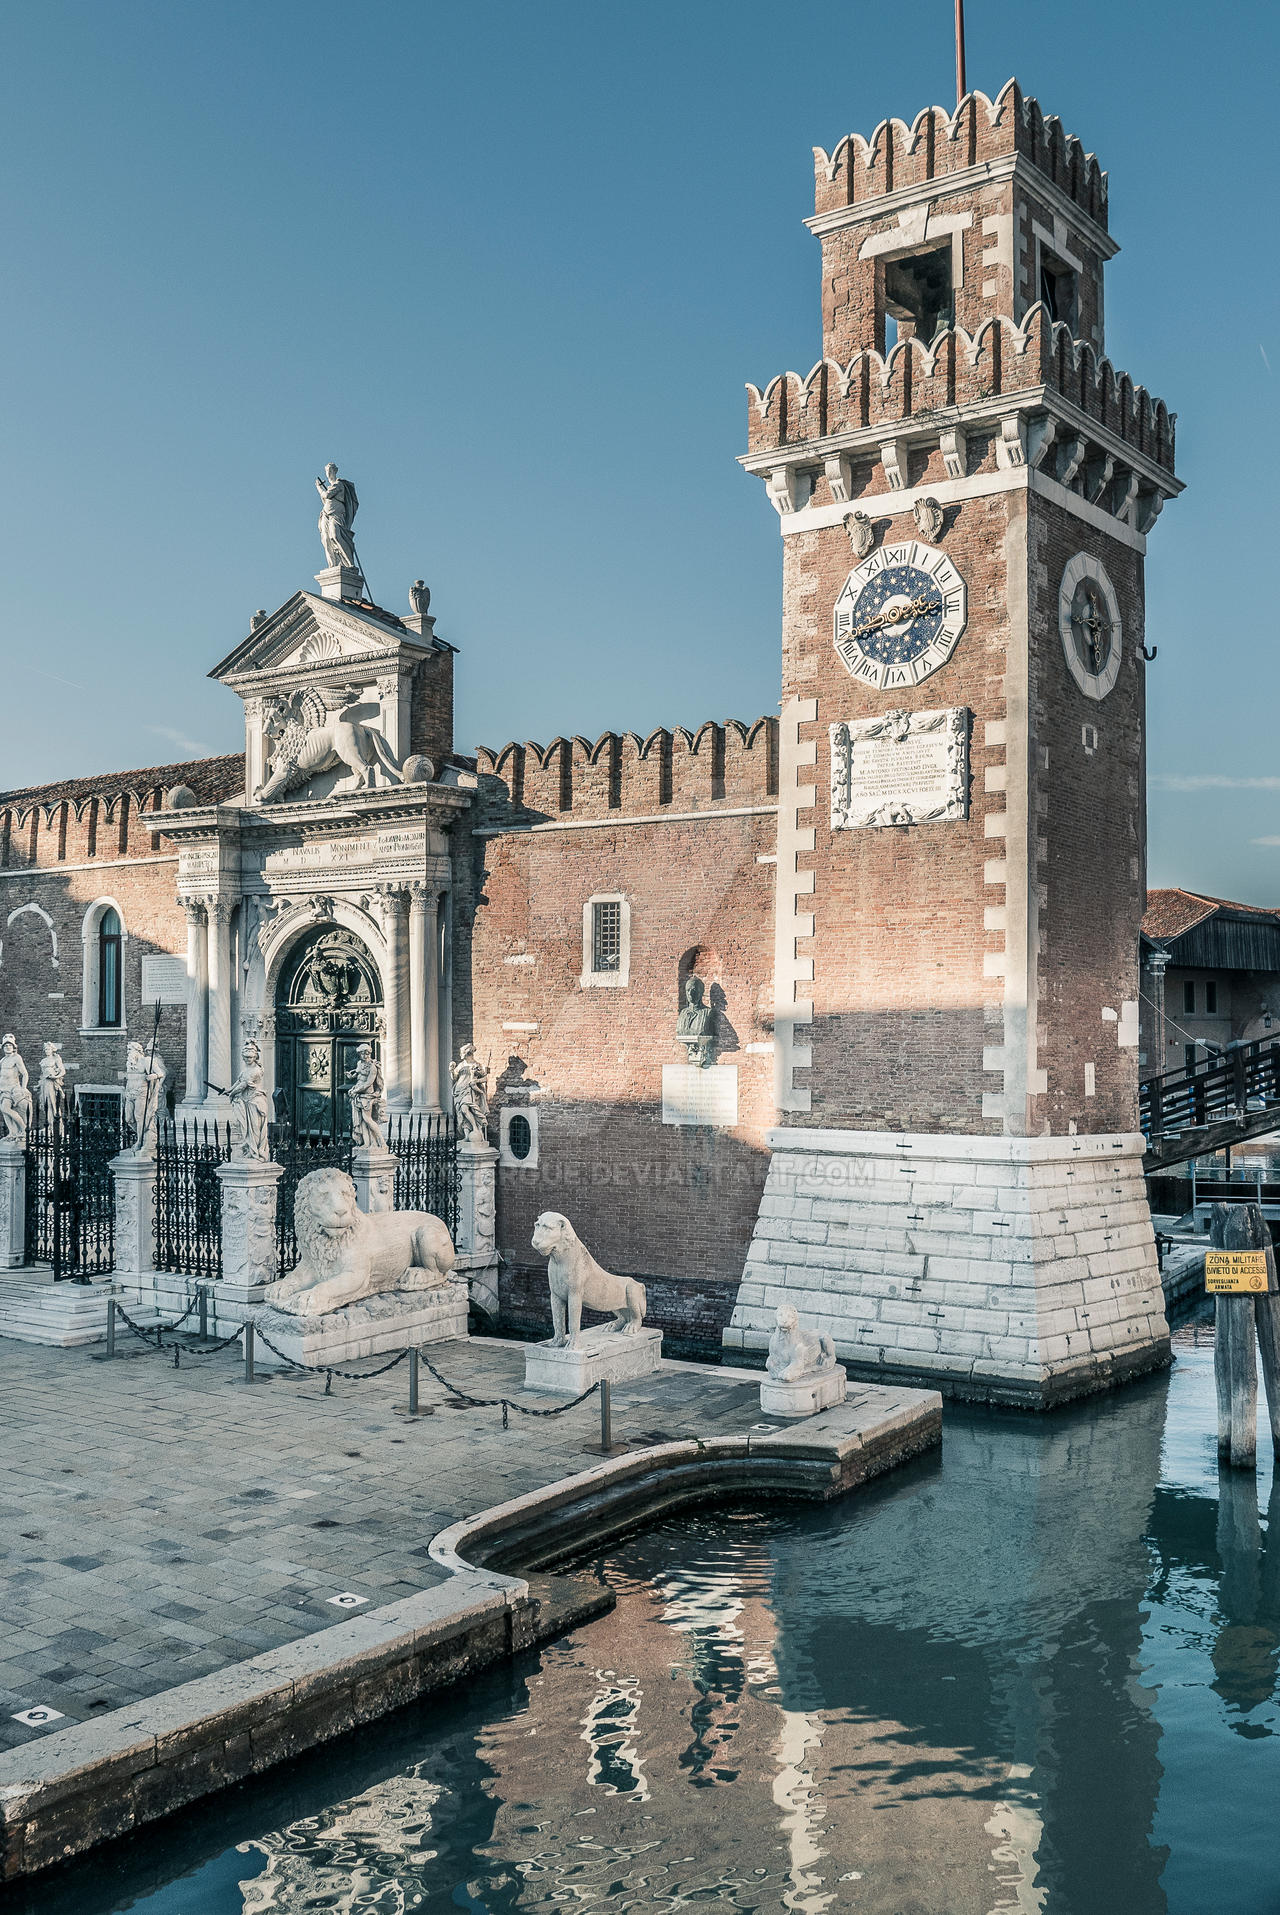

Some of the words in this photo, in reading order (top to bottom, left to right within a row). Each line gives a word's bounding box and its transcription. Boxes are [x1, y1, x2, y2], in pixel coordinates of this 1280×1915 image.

[889, 549, 906, 563] XII
[921, 553, 929, 565] I
[864, 559, 880, 577] XI
[940, 570, 952, 583] II
[844, 586, 858, 600] X
[939, 630, 954, 648] IIII
[844, 642, 858, 665] VIII
[863, 661, 878, 682] VII
[922, 658, 932, 671] V
[892, 669, 905, 683] VI
[1209, 1255, 1230, 1264] ZONA
[1232, 1256, 1264, 1264] MILITARE
